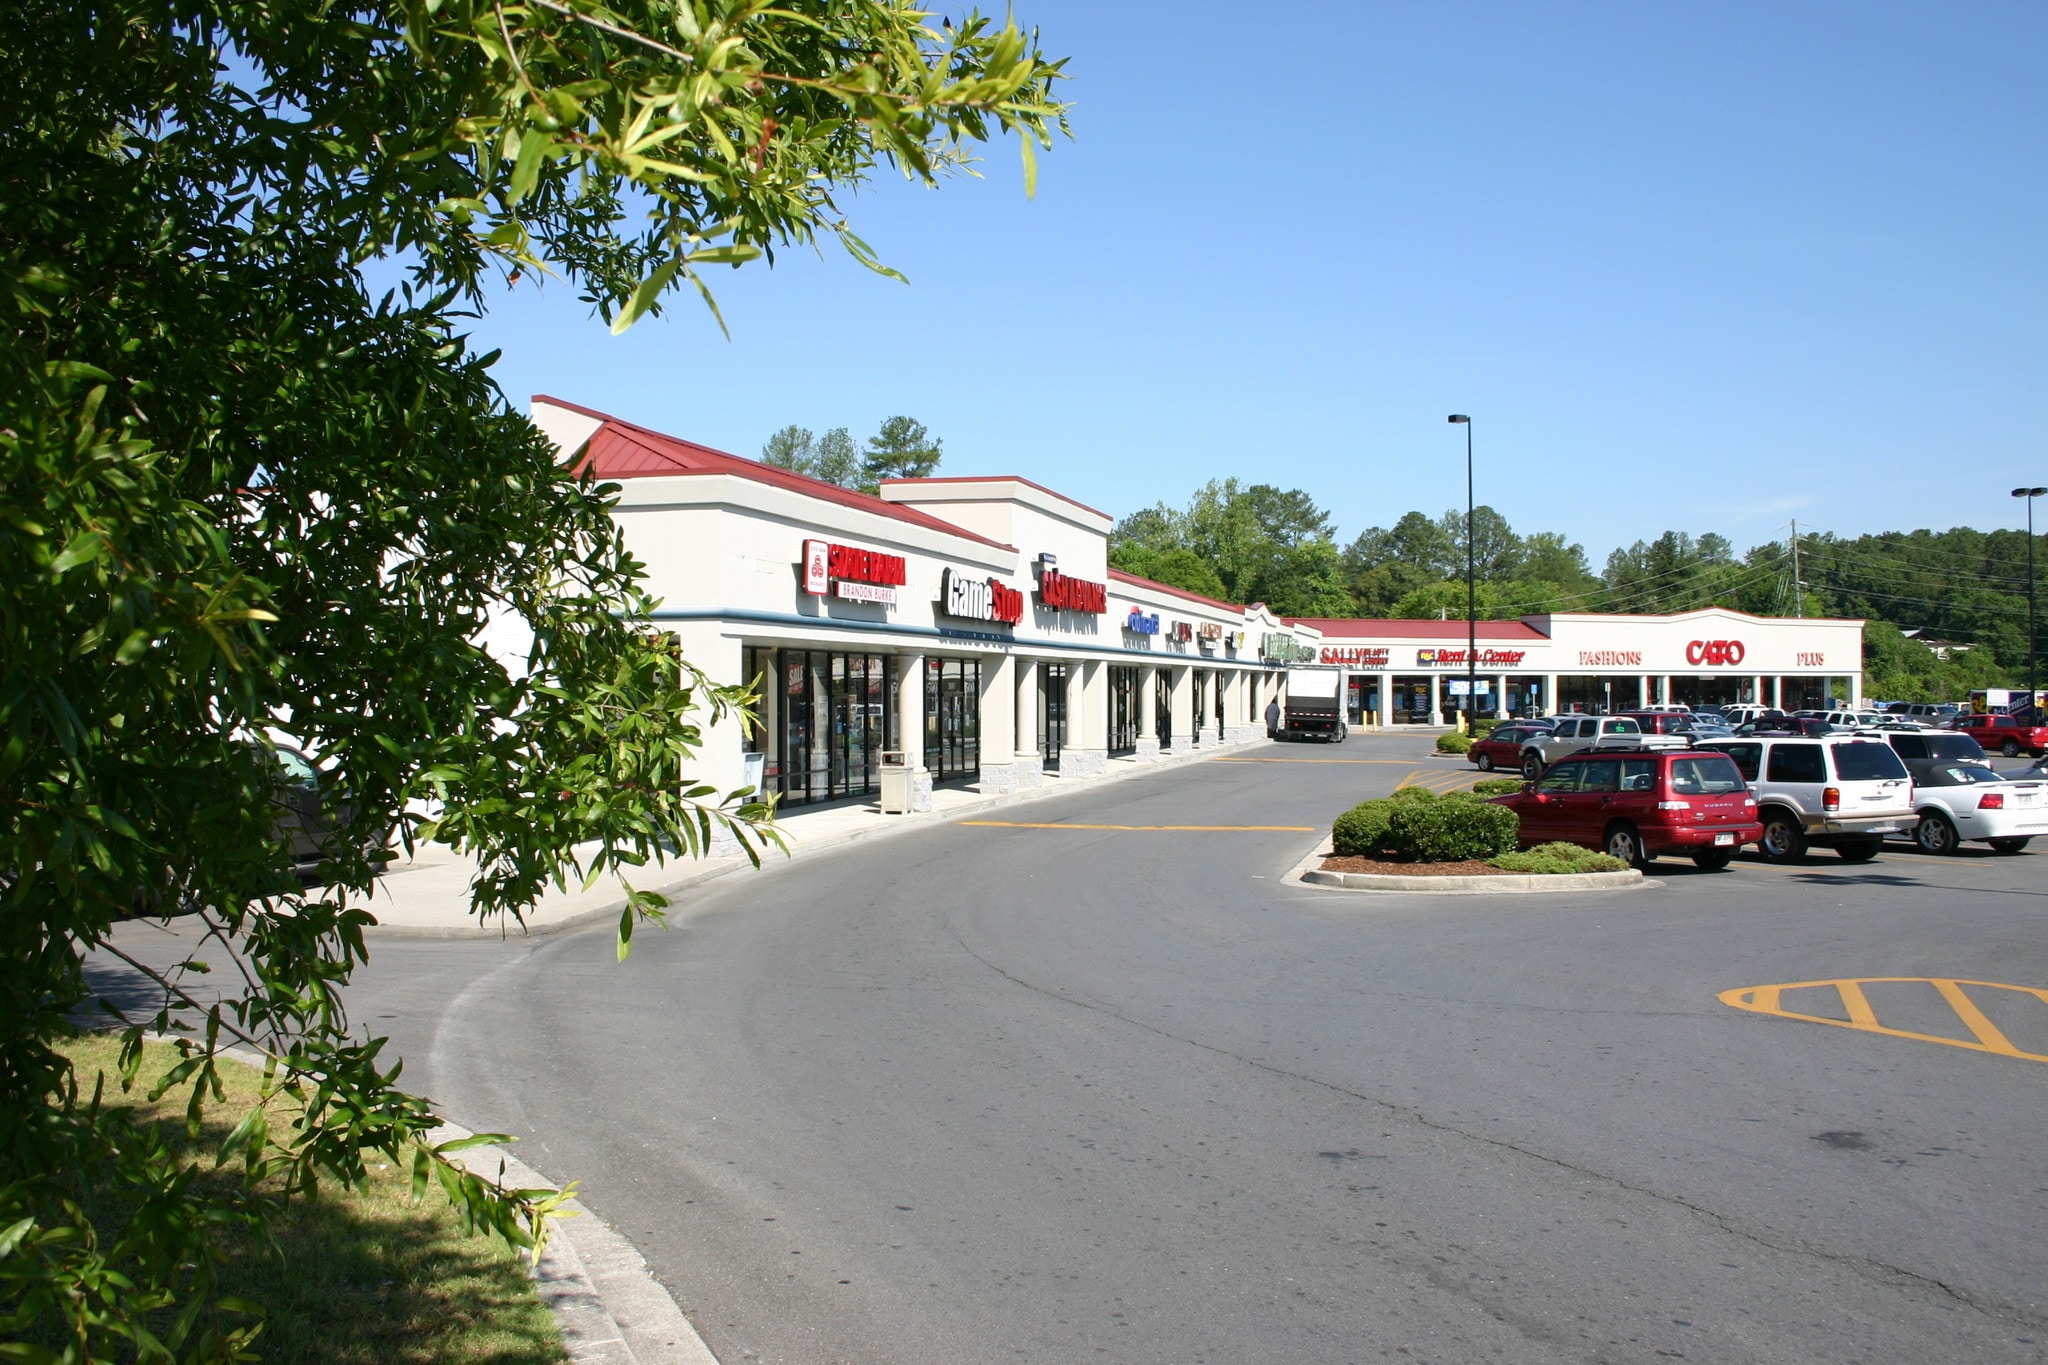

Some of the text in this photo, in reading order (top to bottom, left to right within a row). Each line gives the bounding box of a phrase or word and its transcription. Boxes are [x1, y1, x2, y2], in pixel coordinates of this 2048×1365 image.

[842, 583, 873, 600] BRANDON
[874, 588, 892, 602] BURKE
[943, 568, 1023, 627] GameStop
[1320, 647, 1362, 664] SALLY
[1579, 651, 1642, 665] FASHIONS
[1686, 640, 1745, 666] CATO
[1797, 652, 1824, 666] PLUS
